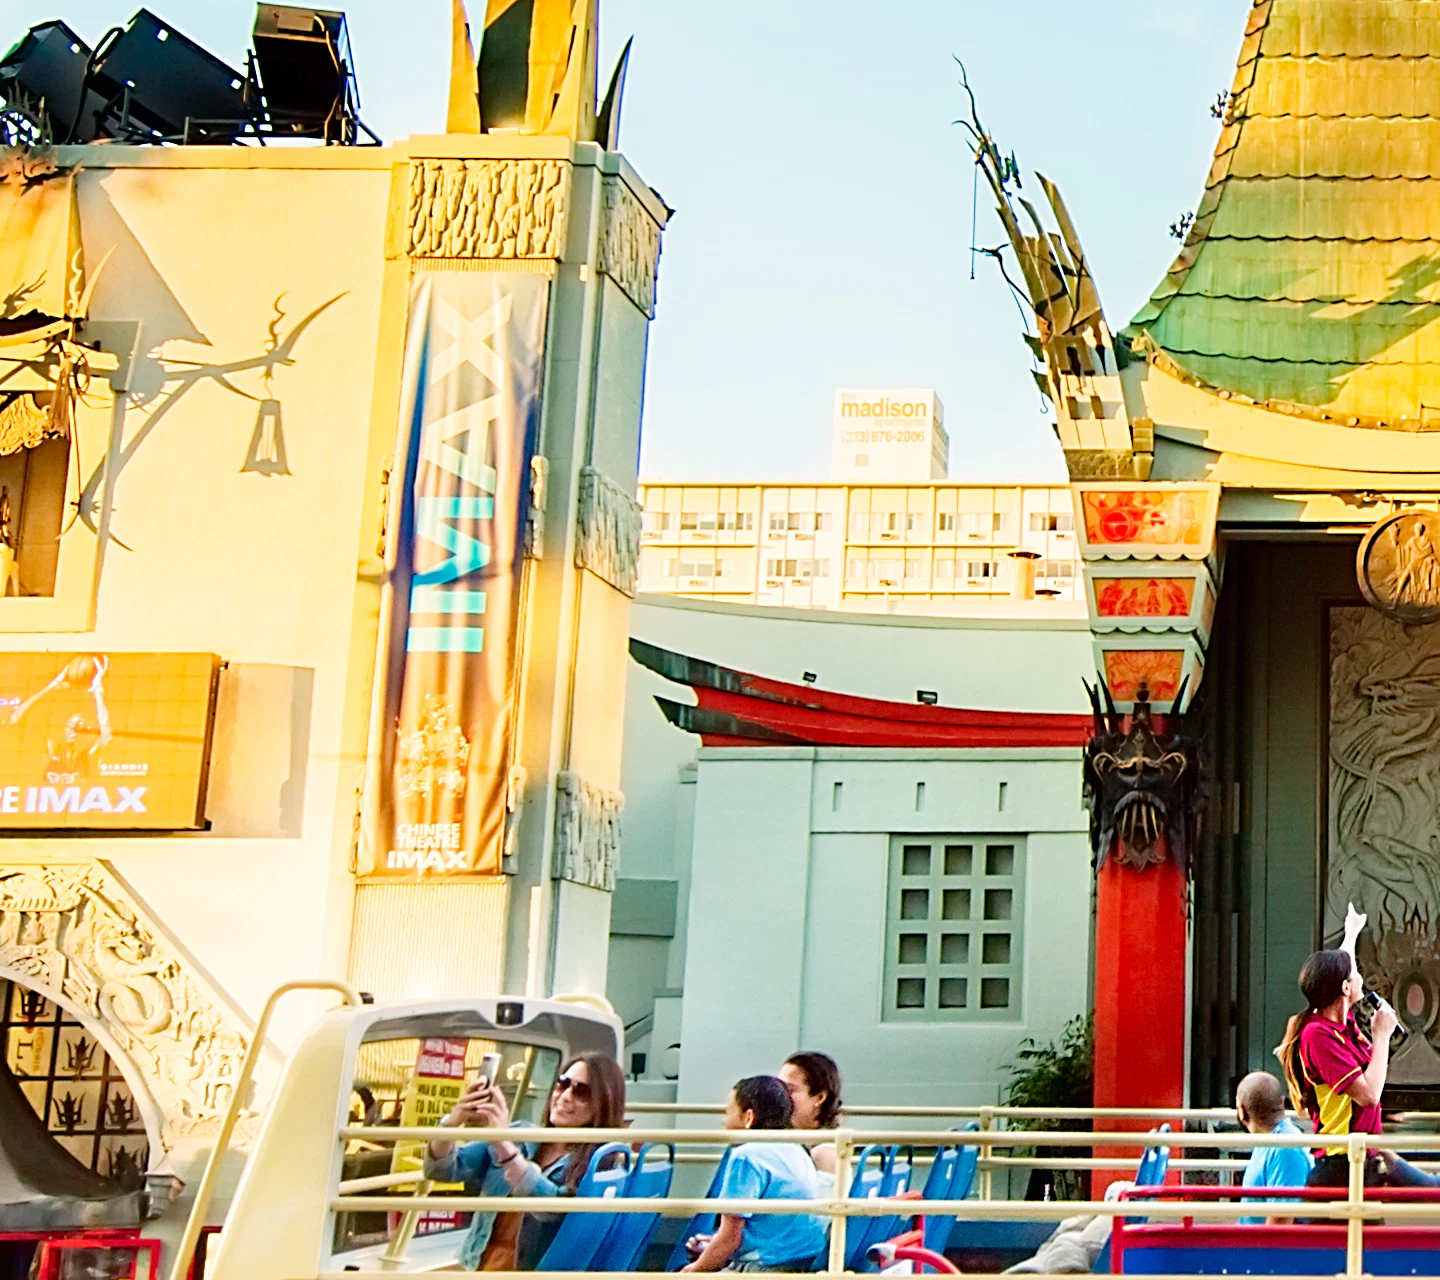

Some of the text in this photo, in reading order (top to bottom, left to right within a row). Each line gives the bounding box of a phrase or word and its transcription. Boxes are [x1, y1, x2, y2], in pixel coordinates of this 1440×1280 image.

[841, 398, 927, 417] madison
[407, 292, 513, 653] IMAX
[25, 785, 148, 814] IMAX
[396, 823, 461, 836] CHINESE
[396, 836, 461, 848] THEATRE
[387, 850, 469, 869] IMAX
